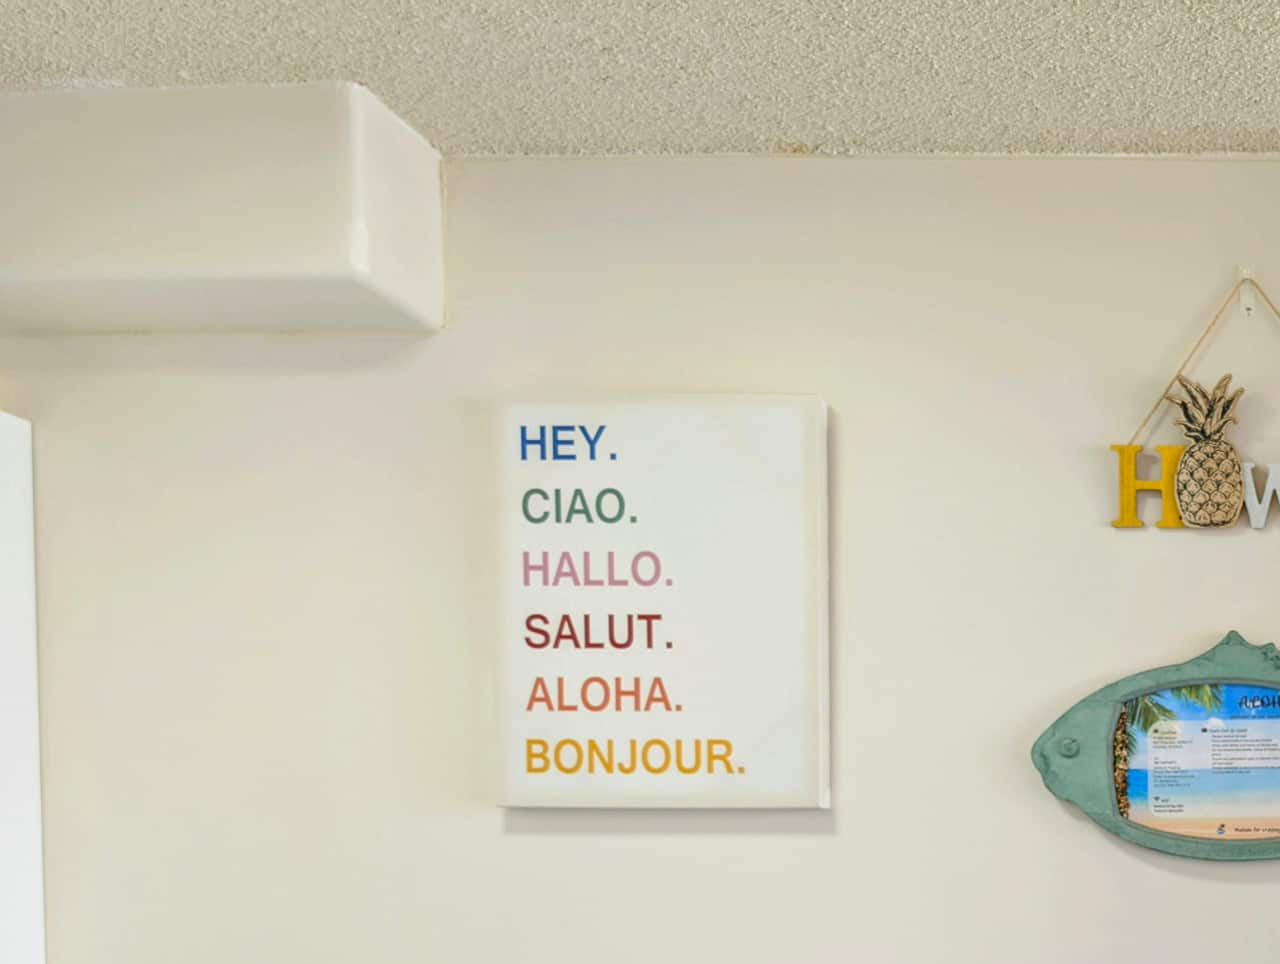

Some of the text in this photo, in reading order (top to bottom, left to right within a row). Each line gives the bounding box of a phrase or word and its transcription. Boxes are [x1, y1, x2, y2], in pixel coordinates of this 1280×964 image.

[520, 425, 618, 461] HEY.
[521, 487, 638, 524] CIAO.
[522, 551, 673, 587] HALLO.
[524, 614, 673, 650] SALUT.
[526, 677, 683, 712] ALOHA.
[525, 739, 746, 775] BONJOUR.
